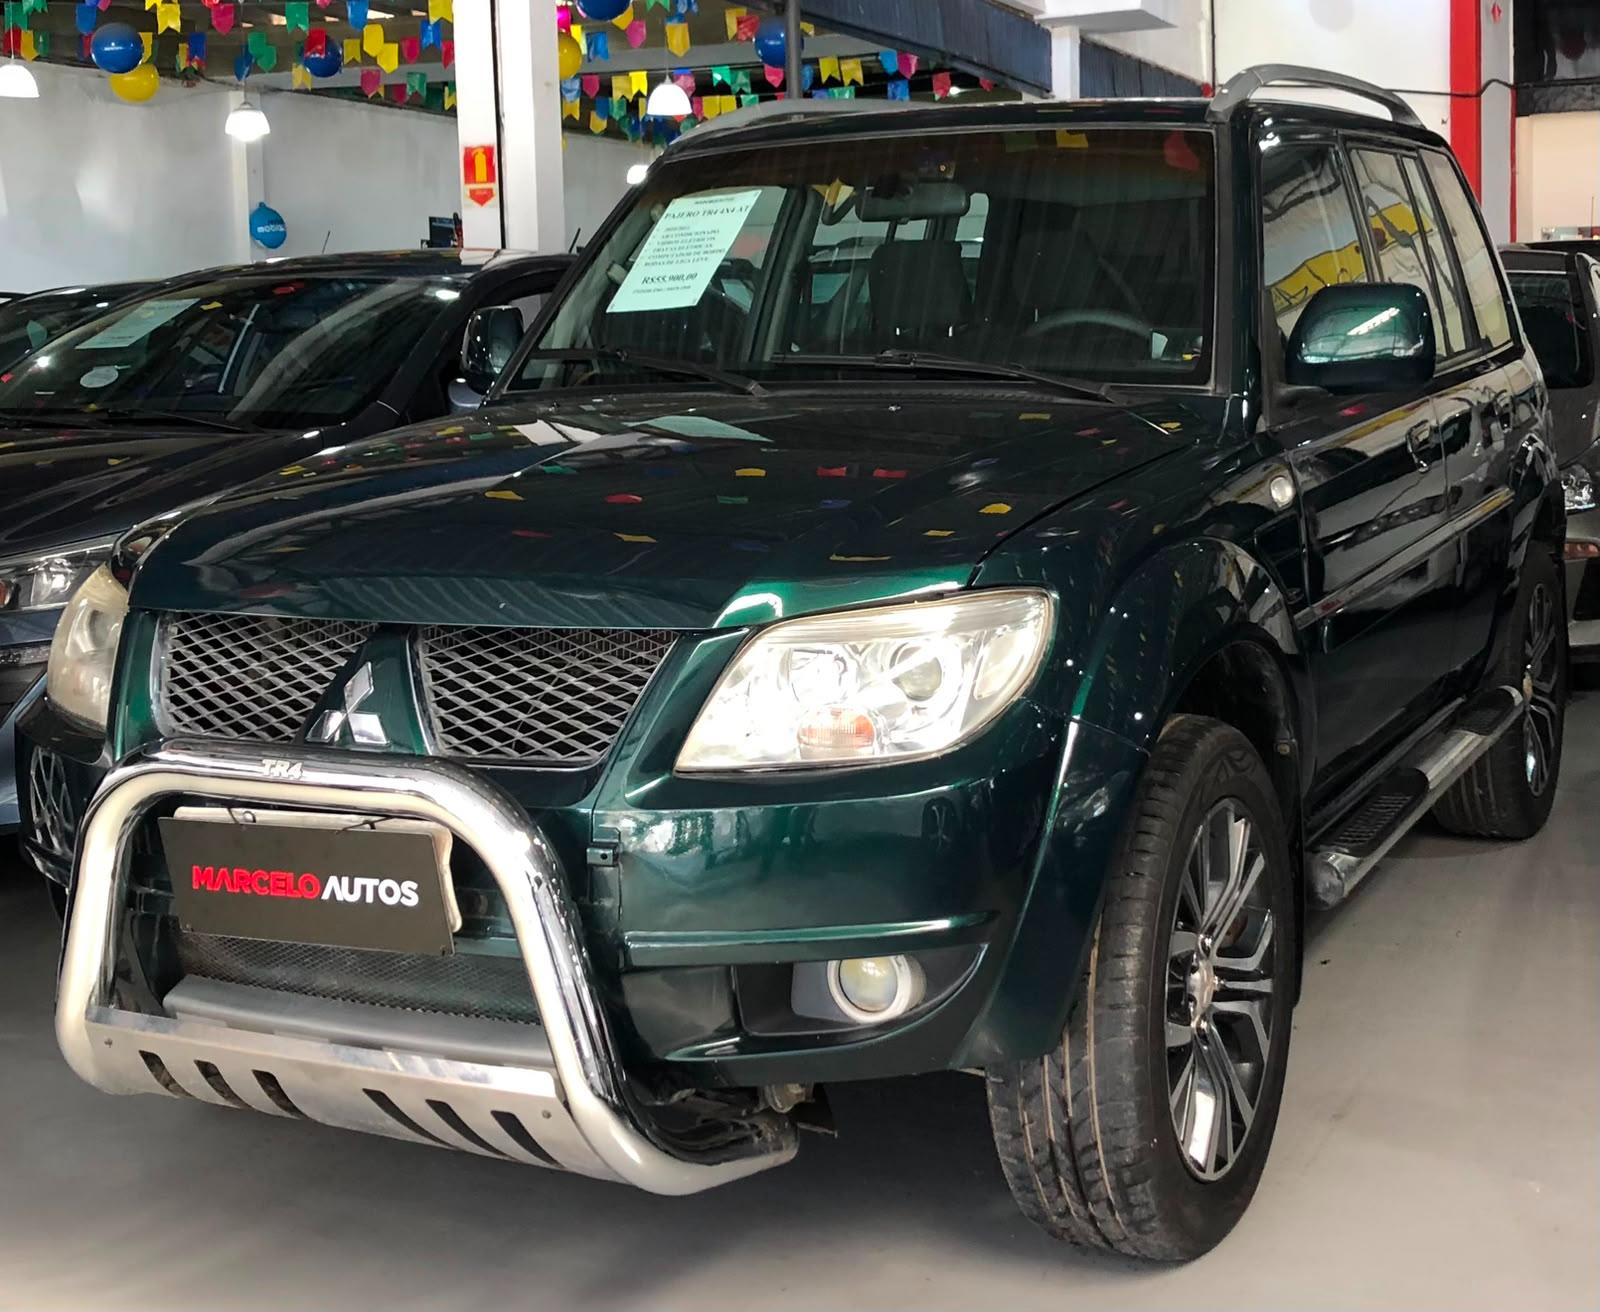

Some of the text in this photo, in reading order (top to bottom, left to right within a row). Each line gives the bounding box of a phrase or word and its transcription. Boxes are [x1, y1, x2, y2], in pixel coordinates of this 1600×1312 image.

[262, 759, 304, 779] TR4
[192, 865, 419, 907] MARCELO AUTOS
